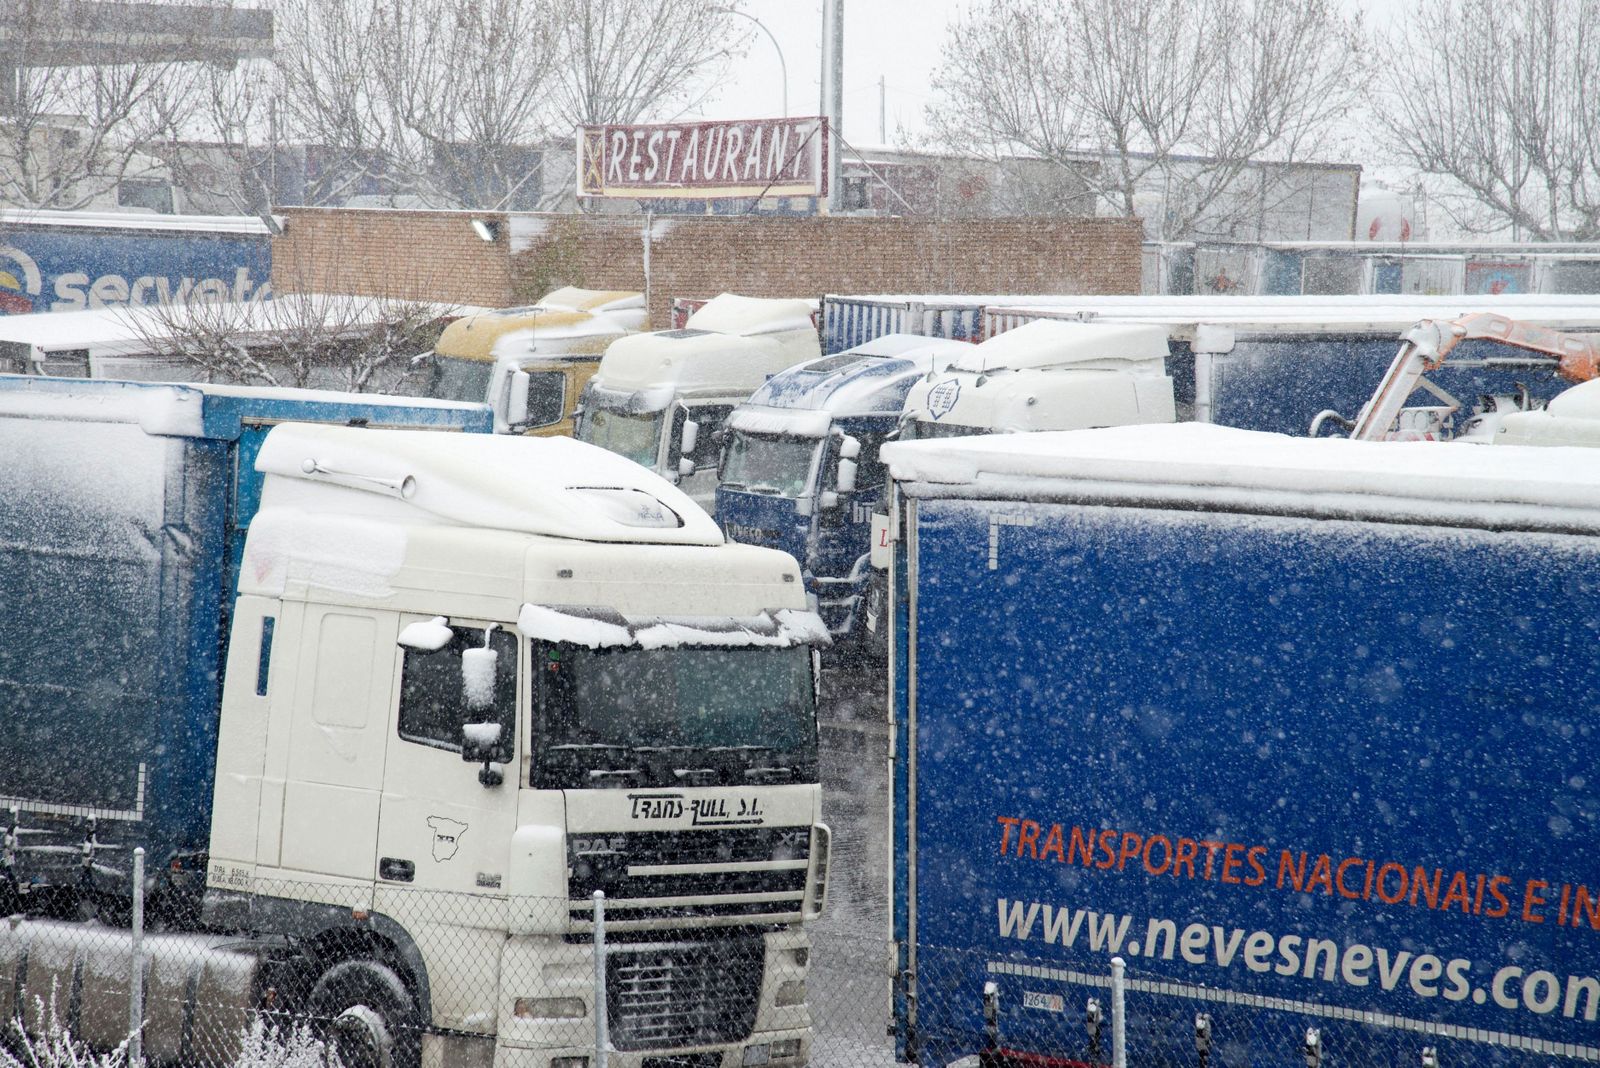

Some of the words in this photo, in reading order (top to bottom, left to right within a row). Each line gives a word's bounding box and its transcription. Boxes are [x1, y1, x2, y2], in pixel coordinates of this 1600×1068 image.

[608, 124, 811, 183] RESTAURANT
[572, 838, 627, 853] DAF
[997, 815, 1268, 887] TRANSPORTES
[1276, 849, 1512, 918] NACIONAIS
[1522, 879, 1550, 923] E
